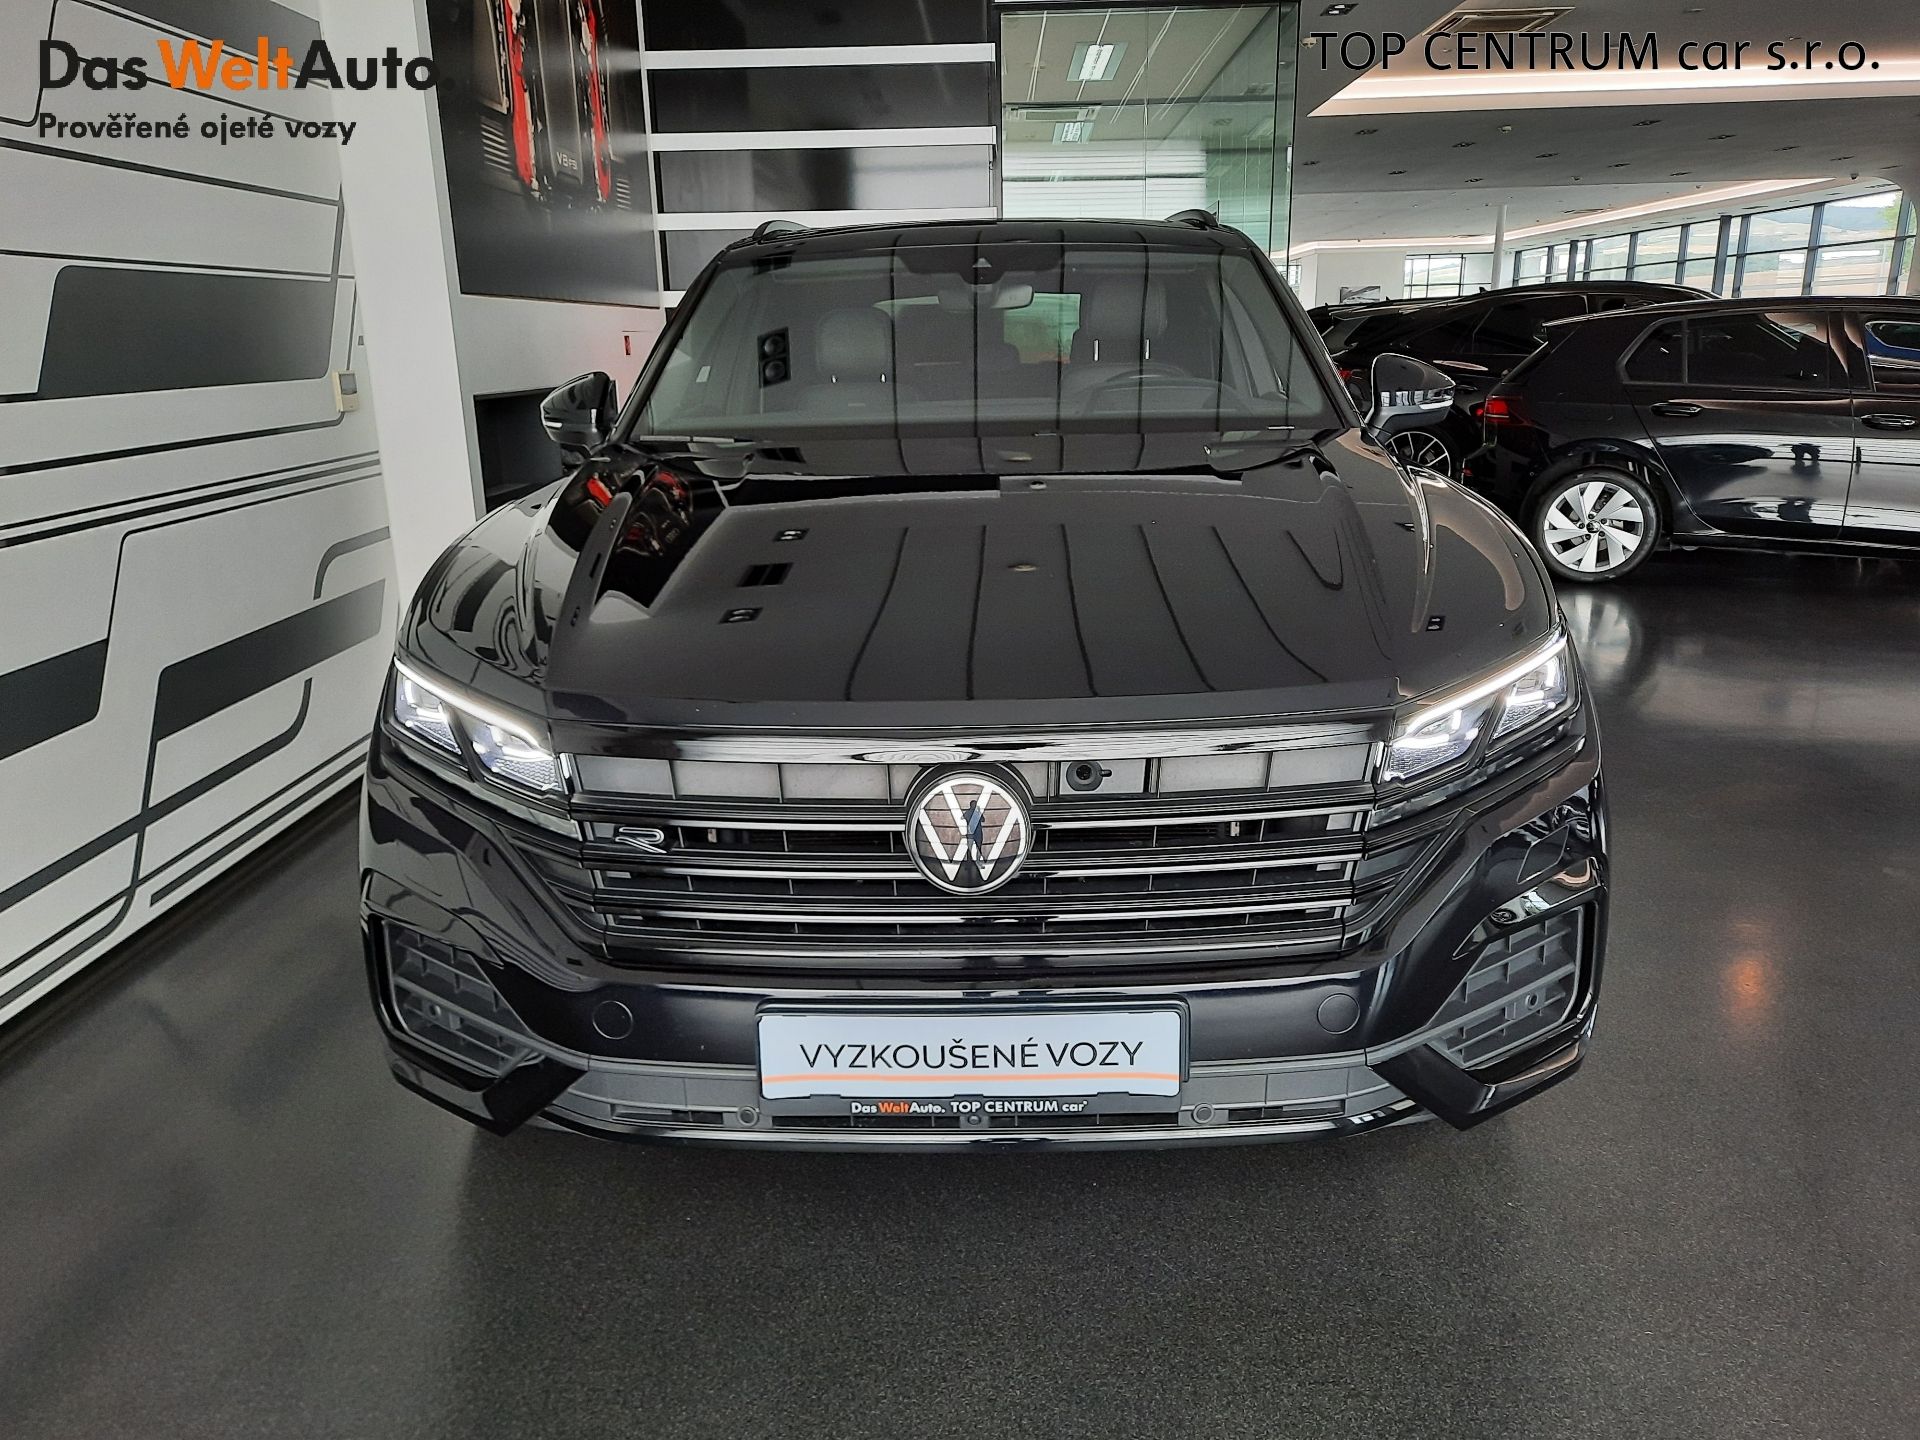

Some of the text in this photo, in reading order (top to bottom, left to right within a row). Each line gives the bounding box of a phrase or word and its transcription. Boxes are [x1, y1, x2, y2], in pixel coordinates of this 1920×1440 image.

[799, 1036, 1143, 1069] VYZKOUŠENÉ VOZY
[851, 1101, 878, 1114] Das
[950, 1101, 981, 1113] TOP
[984, 1100, 1059, 1113] CENTRUM
